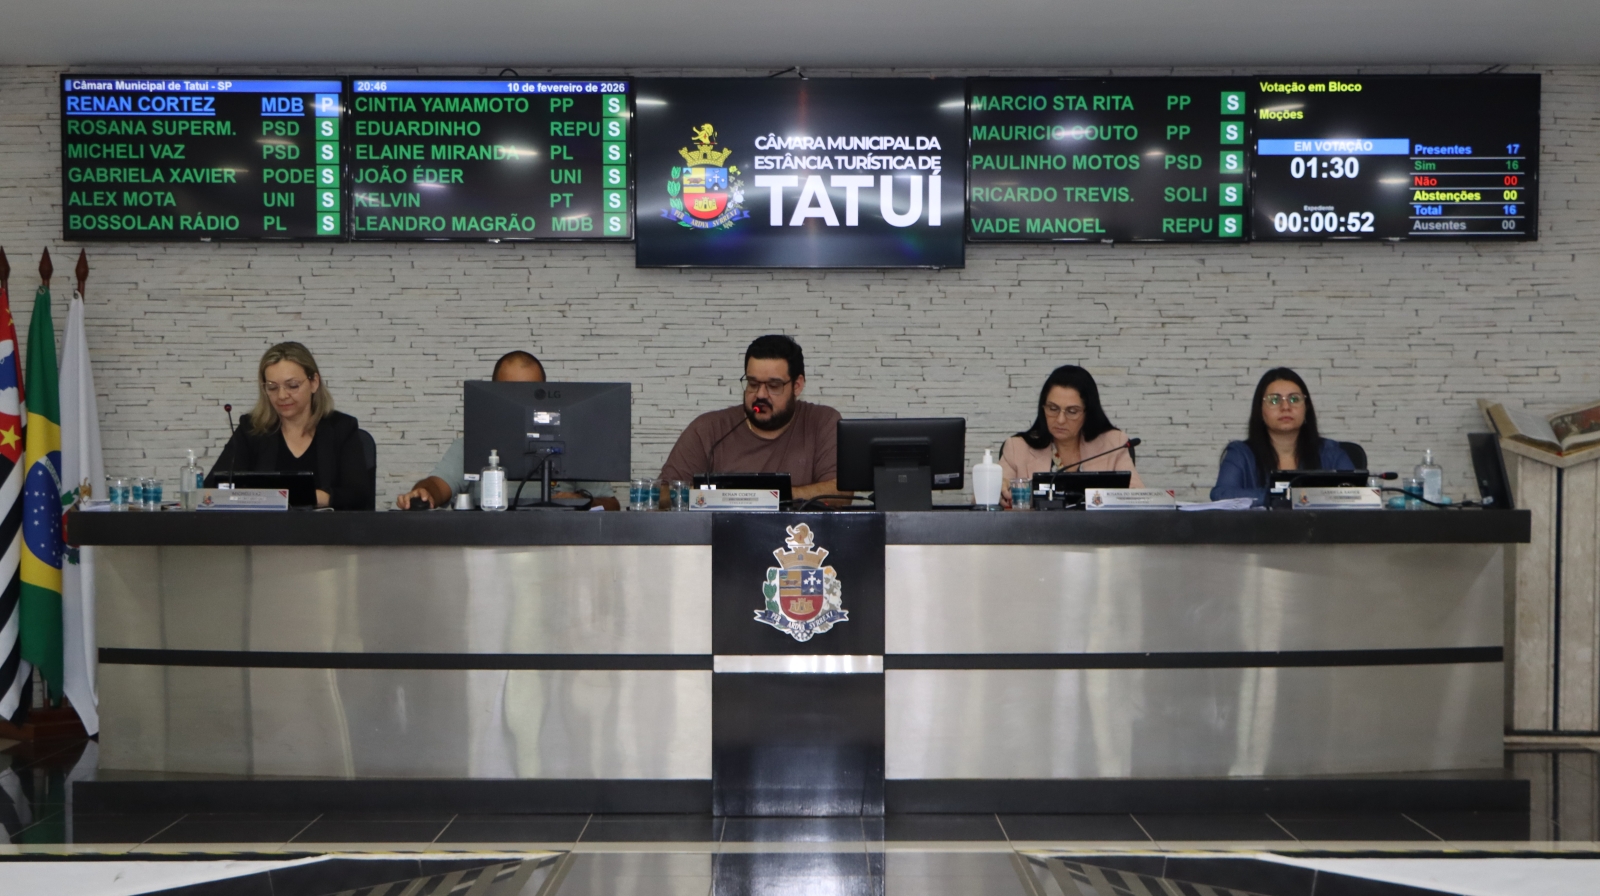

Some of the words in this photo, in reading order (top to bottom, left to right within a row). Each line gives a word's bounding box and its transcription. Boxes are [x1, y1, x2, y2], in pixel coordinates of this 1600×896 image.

[73, 80, 113, 91] Câmara
[115, 81, 165, 92] Municipal
[168, 81, 182, 91] de
[218, 82, 232, 91] SP
[357, 82, 387, 91] 20:46
[507, 83, 519, 92] 10
[522, 83, 535, 92] de
[537, 83, 582, 92] fevereiro
[585, 83, 598, 92] de
[601, 83, 625, 92] 2026
[1260, 82, 1305, 93] Votação
[1308, 84, 1325, 92] em
[1328, 82, 1362, 92] Bloco
[66, 96, 132, 112] RENAN
[137, 96, 216, 112] CORTEZ
[261, 98, 304, 112] MDB
[321, 98, 333, 112] P
[355, 97, 417, 112] CINTIA
[420, 97, 529, 112] YAMAMOTO
[550, 98, 574, 112] PP
[608, 98, 620, 113] S
[972, 96, 1047, 110] MARCIO
[1053, 96, 1088, 111] STA
[1093, 96, 1134, 110] RITA
[1167, 96, 1191, 110] PP
[1227, 95, 1239, 110] S
[1259, 109, 1303, 121] Moções
[67, 120, 147, 135] ROSANA
[152, 121, 237, 136] SUPERM.
[262, 121, 299, 136] PSD
[321, 122, 333, 137] S
[356, 121, 481, 136] EDUARDINHO
[550, 122, 600, 136] REPU
[608, 122, 621, 137] S
[972, 125, 1065, 140] MAURICIO
[1071, 125, 1138, 140] COUTO
[1167, 126, 1190, 140] PP
[1226, 125, 1238, 140] S
[755, 133, 826, 150] CÂMARA
[828, 136, 915, 150] MUNICIPAL
[916, 136, 941, 150] DA
[1294, 142, 1312, 151] EM
[1315, 139, 1373, 153] VOTAÇÃO
[1414, 145, 1472, 154] Presentes
[1507, 144, 1520, 154] 17
[68, 144, 144, 159] MICHELI
[149, 144, 185, 159] VAZ
[263, 145, 300, 159] PSD
[321, 145, 334, 160] S
[356, 145, 425, 159] ELAINE
[431, 145, 519, 160] MIRANDA
[550, 146, 573, 160] PL
[608, 145, 621, 160] S
[755, 153, 832, 170] ESTÂNCIA
[834, 153, 916, 170] TURÍSTICA
[918, 156, 941, 170] DE
[972, 155, 1066, 170] PAULINHO
[1073, 155, 1140, 170] MOTOS
[1165, 155, 1202, 170] PSD
[1225, 154, 1238, 170] S
[1290, 157, 1359, 179] 01:30
[1414, 161, 1436, 170] Sim
[1506, 161, 1519, 170] 16
[68, 168, 165, 183] GABRIELA
[170, 168, 236, 183] XAVIER
[263, 169, 315, 183] PODE
[321, 169, 334, 184] S
[355, 165, 407, 184] JOÃO
[413, 165, 464, 183] ÉDER
[551, 169, 581, 184] UNI
[608, 169, 621, 184] S
[1414, 176, 1437, 186] Não
[1504, 176, 1518, 185] 00
[68, 192, 118, 207] ALEX
[123, 192, 176, 207] MOTA
[264, 193, 295, 207] UNI
[322, 193, 334, 207] S
[355, 193, 420, 207] KELVIN
[550, 194, 573, 207] PT
[609, 193, 621, 208] S
[755, 170, 941, 227] TATUÍ
[972, 187, 1057, 202] RICARDO
[1063, 187, 1135, 202] TREVIS.
[1164, 188, 1207, 202] SOLI
[1225, 187, 1237, 202] S
[1413, 191, 1481, 202] Abstenções
[1504, 191, 1517, 200] 00
[1414, 205, 1442, 215] Total
[1504, 205, 1517, 215] 16
[69, 215, 174, 230] BOSSOLAN
[180, 212, 239, 230] RÁDIO
[264, 216, 286, 231] PL
[322, 216, 335, 231] S
[355, 216, 446, 231] LEANDRO
[451, 213, 536, 231] MAGRÃO
[552, 217, 593, 231] MDB
[609, 216, 621, 231] S
[971, 218, 1020, 233] VADE
[1026, 218, 1105, 233] MANOEL
[1163, 219, 1213, 233] REPU
[1224, 218, 1237, 233] S
[1274, 212, 1374, 232] 00:00:52
[1413, 221, 1466, 230] Ausentes
[1502, 220, 1516, 230] 00
